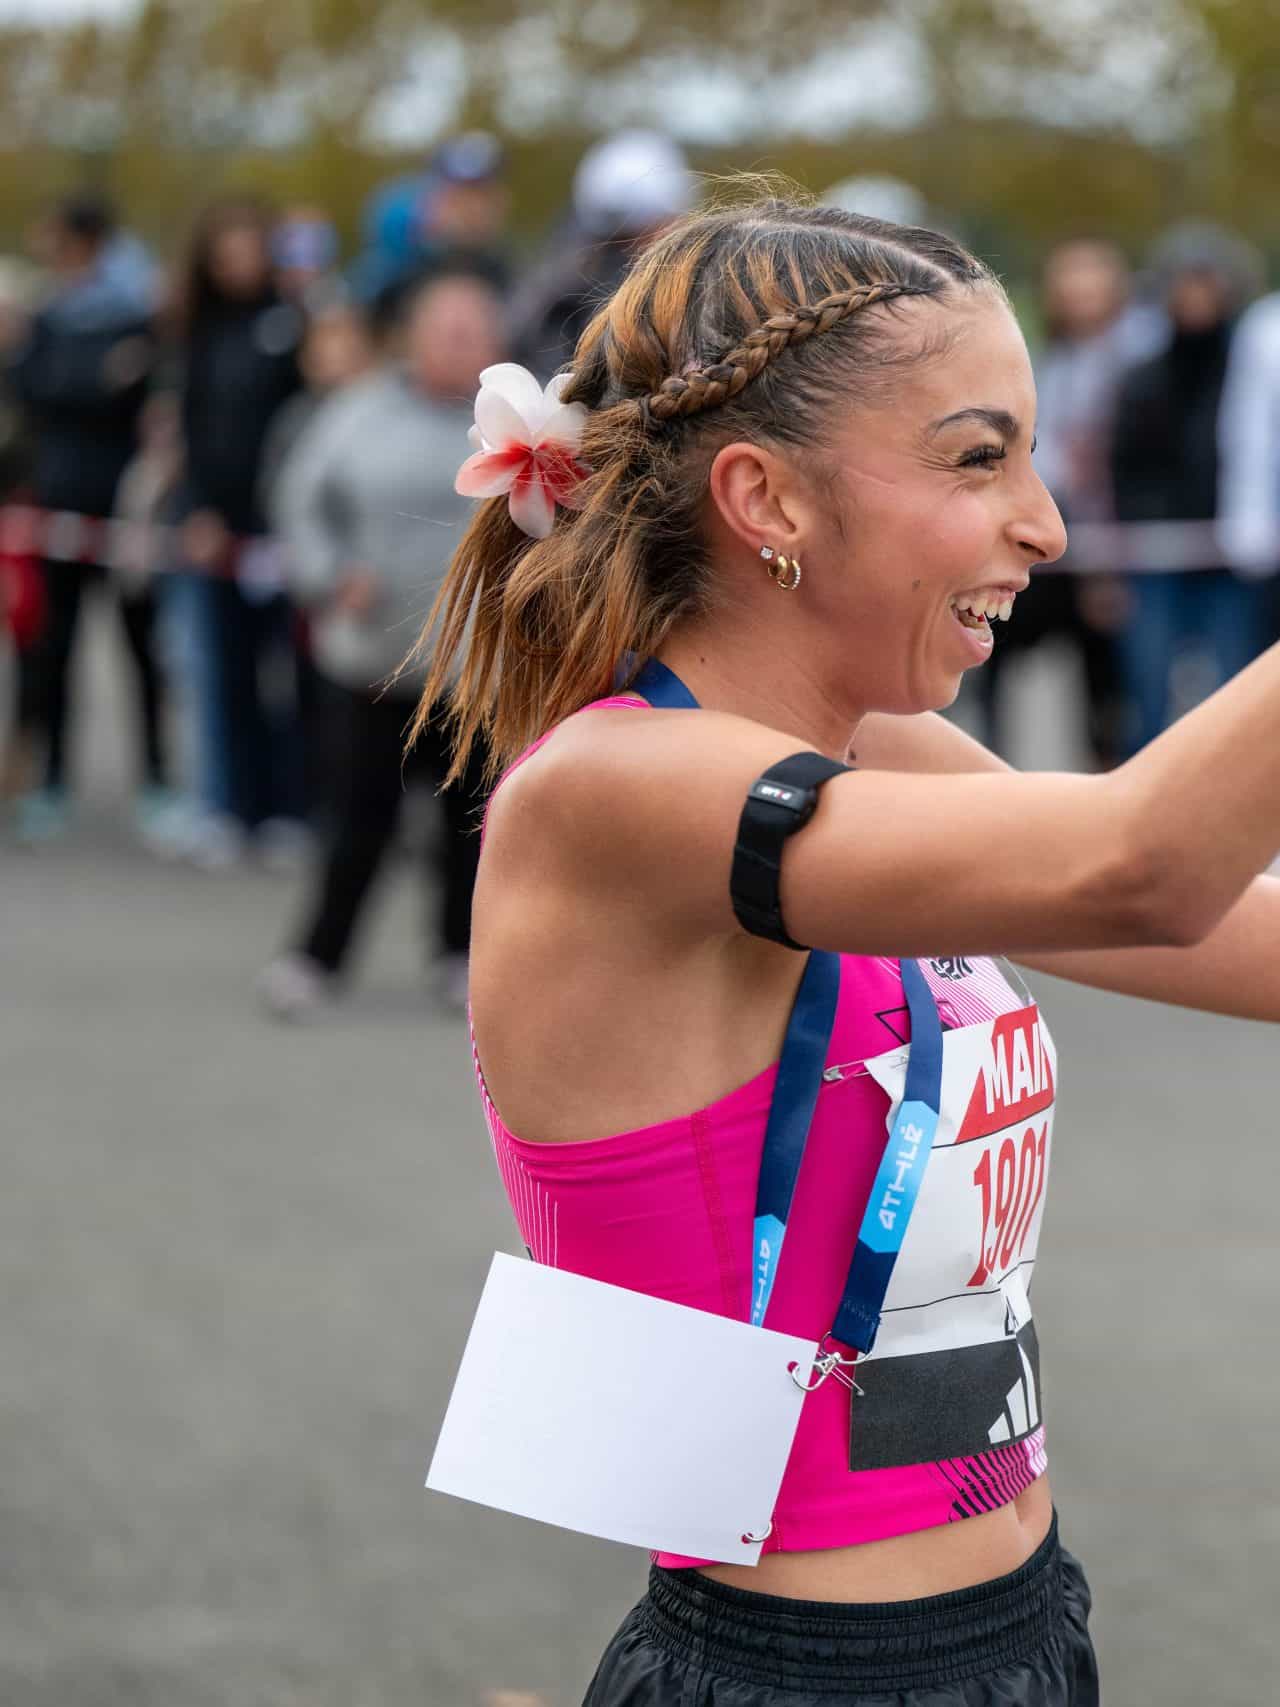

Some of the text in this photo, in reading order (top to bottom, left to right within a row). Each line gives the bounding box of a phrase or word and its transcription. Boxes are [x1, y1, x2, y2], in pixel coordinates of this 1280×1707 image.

[878, 1122, 924, 1231] ATHLÉ
[966, 1121, 1047, 1287] 1901
[751, 1239, 771, 1323] ATHL
